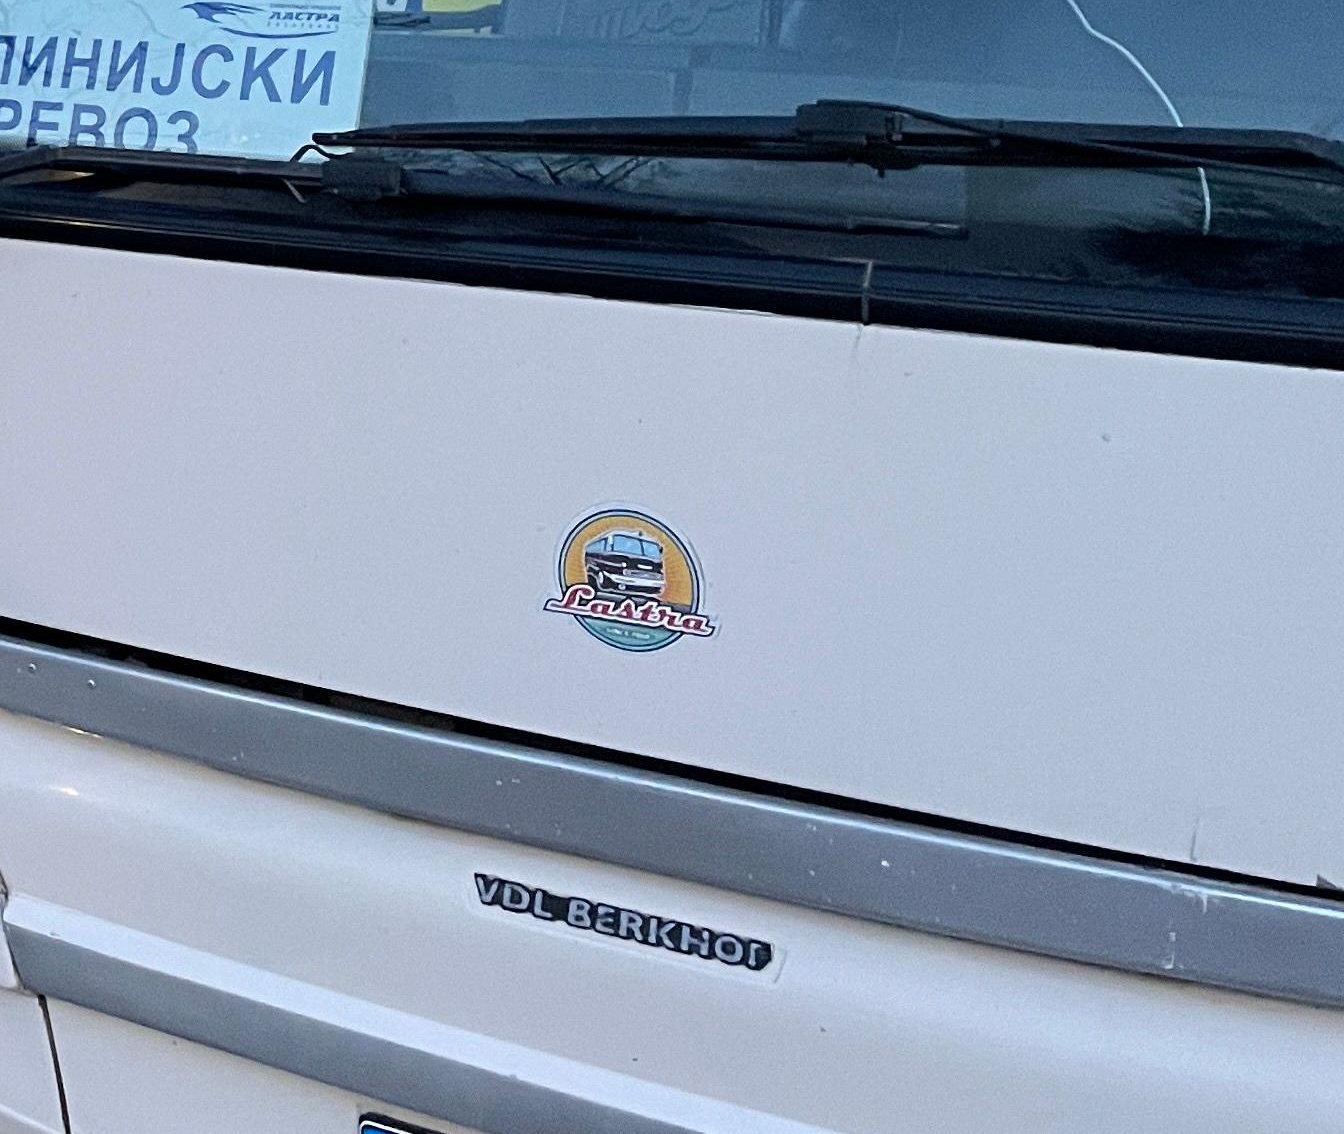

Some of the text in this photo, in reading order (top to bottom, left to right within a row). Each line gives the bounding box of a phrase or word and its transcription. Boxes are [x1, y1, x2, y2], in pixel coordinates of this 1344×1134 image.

[268, 10, 341, 23] ЛАСТРА
[544, 584, 714, 636] Lastra
[475, 875, 554, 919] VDL
